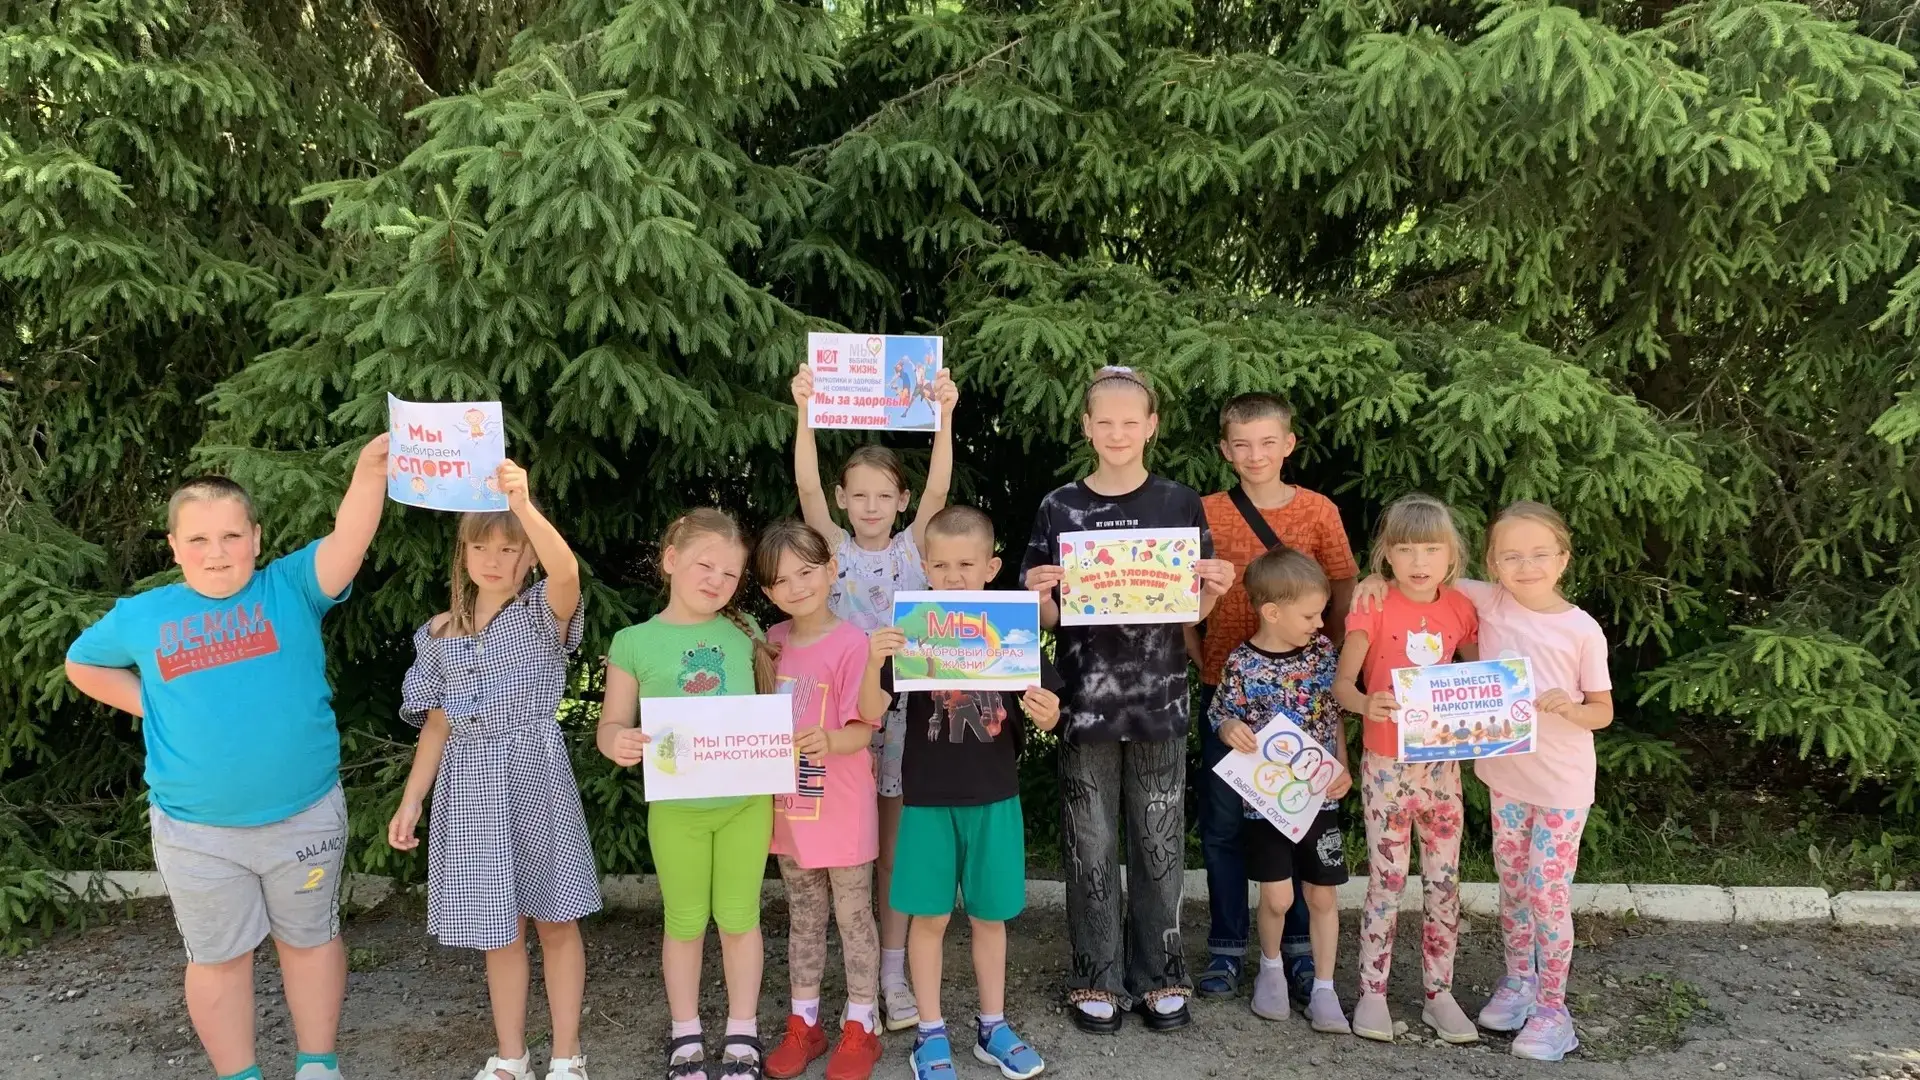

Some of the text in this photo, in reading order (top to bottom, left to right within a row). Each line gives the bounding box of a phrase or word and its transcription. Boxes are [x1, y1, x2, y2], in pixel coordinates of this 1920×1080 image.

[849, 364, 878, 375] ЖИЗНЬ
[815, 392, 835, 405] Мы
[837, 395, 850, 405] за
[815, 411, 848, 426] образ
[408, 423, 443, 443] Мы
[400, 444, 461, 459] выбираем
[397, 455, 471, 478] СПОРТ!
[1080, 573, 1101, 583] МЫ
[1104, 570, 1117, 578] ЗА
[1093, 579, 1127, 590] ОБРАЗ
[160, 602, 266, 658] DENIM
[928, 611, 987, 638] МЫ
[191, 648, 245, 668] CLASSIC
[986, 648, 1024, 658] ОБРАЗ
[942, 661, 986, 670] ЖИЗНИ!
[1430, 675, 1500, 689] МЫ ВМЕСТЕ
[1431, 684, 1503, 703] ПРОТИВ
[1433, 698, 1504, 713] НАРКОТИКОВ
[693, 733, 792, 748] МЫ ПРОТИВ
[694, 748, 792, 761] НАРКОТИКОВ!
[1225, 769, 1234, 777] Я
[1233, 776, 1267, 807] ВЫБИРАЮ
[303, 866, 325, 889] 2
